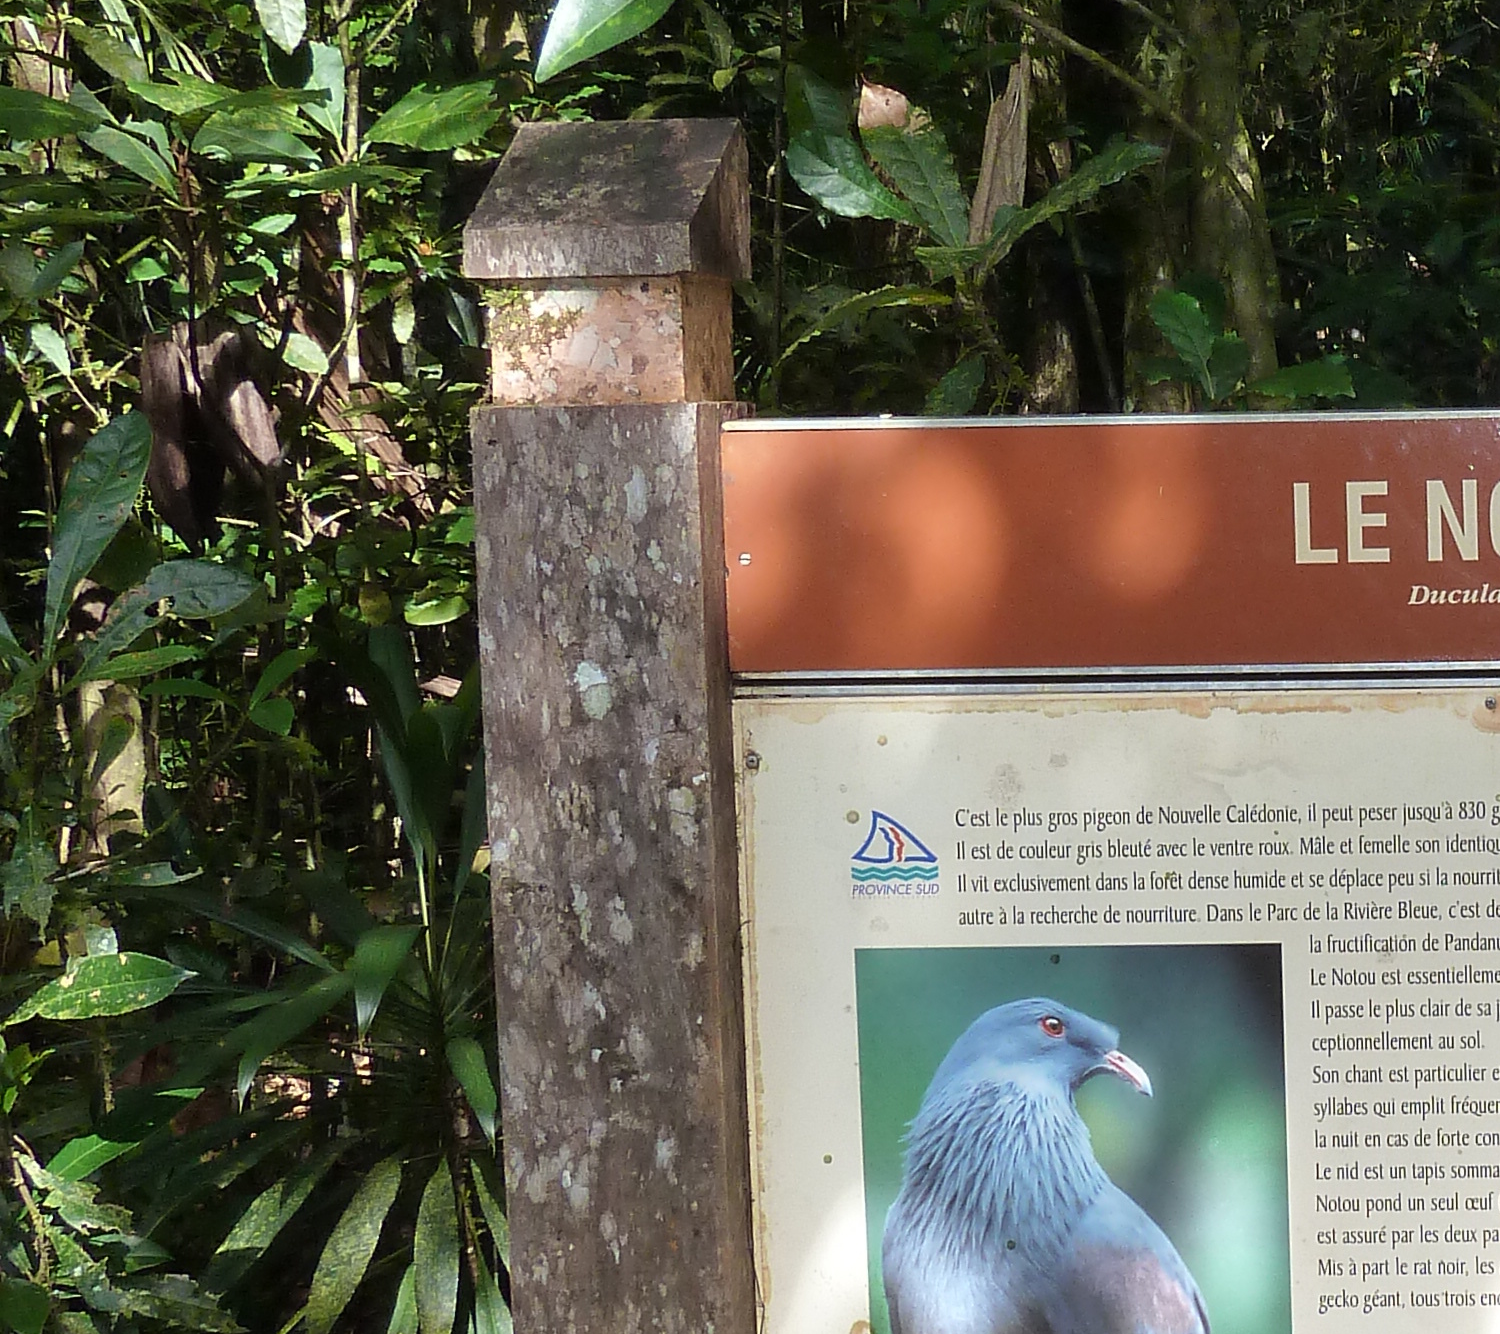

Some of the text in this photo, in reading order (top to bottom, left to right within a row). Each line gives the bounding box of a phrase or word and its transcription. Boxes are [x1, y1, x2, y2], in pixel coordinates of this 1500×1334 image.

[1293, 480, 1390, 565] LE
[955, 808, 991, 827] C'est
[995, 807, 1009, 827] le
[1013, 806, 1043, 834] plus
[1047, 812, 1078, 833] gros
[1083, 808, 1131, 833] pigeon
[1135, 805, 1154, 825] de
[1158, 804, 1222, 825] Nouvelle
[1226, 803, 1302, 832] Calédonie,
[1307, 802, 1317, 822] il
[1322, 805, 1354, 829] peut
[1358, 807, 1398, 829] peser
[1402, 800, 1453, 827] jusqu'à
[1458, 801, 1486, 820] 830
[956, 840, 966, 860] Il
[970, 843, 992, 860] est
[996, 840, 1014, 860] de
[1018, 839, 1072, 859] couleur
[1076, 840, 1103, 866] gris
[1107, 838, 1152, 858] bleuté
[1156, 843, 1188, 857] avec
[1192, 837, 1206, 857] le
[1209, 839, 1254, 856] ventre
[1258, 841, 1294, 856] roux.
[1299, 835, 1336, 855] Mâle
[1339, 837, 1354, 854] et
[1358, 833, 1411, 854] femelle
[1414, 839, 1441, 853] son
[852, 883, 940, 896] PROVINCE SUD
[1310, 967, 1327, 986] Le
[1331, 967, 1376, 986] Notou
[1381, 968, 1402, 985] est
[1311, 999, 1320, 1018] Il
[1324, 1004, 1364, 1025] passe
[1368, 998, 1381, 1018] le
[1385, 997, 1416, 1025] plus
[1419, 997, 1451, 1017] clair
[1454, 997, 1473, 1017] de
[1476, 1002, 1492, 1017] sa
[1311, 1030, 1484, 1058] ceptionnellement au sol.
[1314, 1128, 1327, 1148] la
[1332, 1130, 1359, 1148] nuit
[1364, 1134, 1381, 1148] en
[1386, 1133, 1409, 1148] cas
[1413, 1127, 1432, 1147] de
[1436, 1127, 1470, 1147] forte
